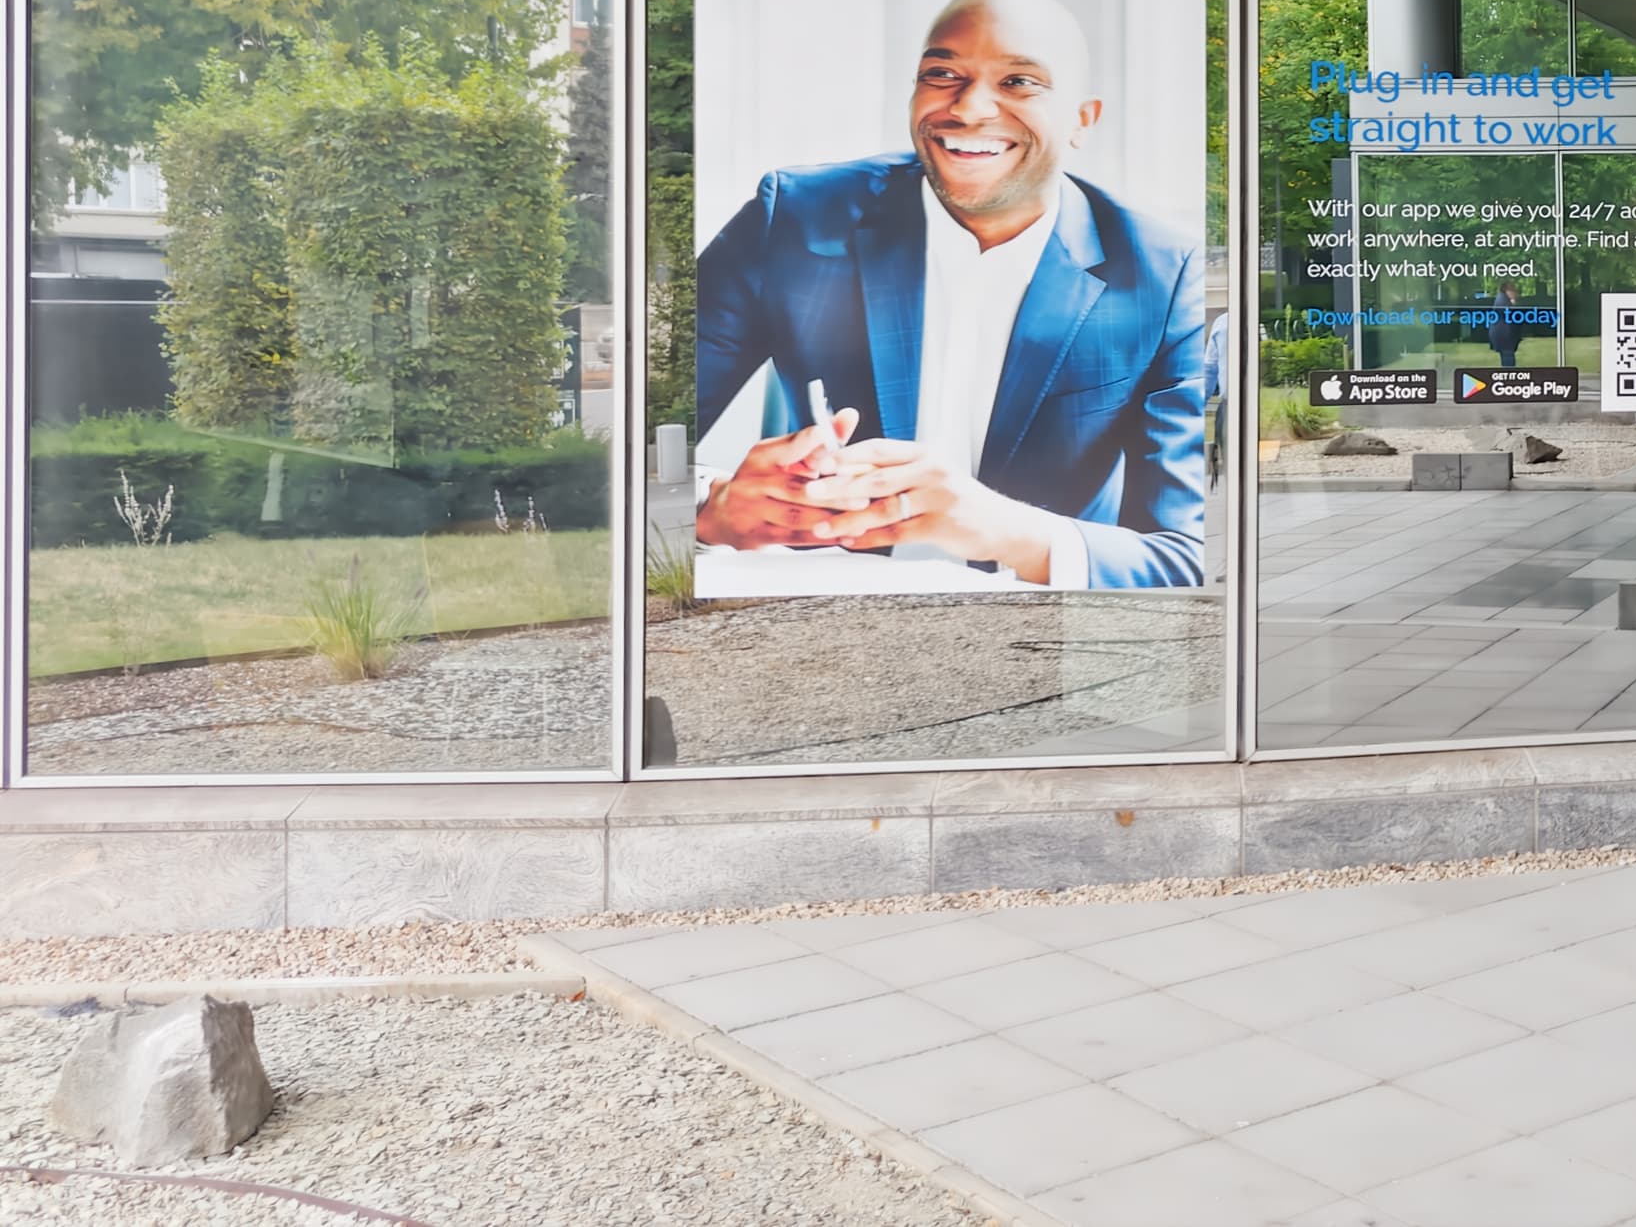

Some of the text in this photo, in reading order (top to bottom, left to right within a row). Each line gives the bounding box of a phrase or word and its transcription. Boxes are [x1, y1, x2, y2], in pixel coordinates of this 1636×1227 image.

[1310, 60, 1616, 107] Plug-in and get
[1309, 110, 1618, 153] straight to work
[1307, 199, 1355, 218] With
[1361, 202, 1397, 218] our
[1400, 202, 1441, 222] app
[1445, 203, 1476, 218] we
[1480, 200, 1523, 223] give
[1526, 203, 1562, 223] you
[1568, 202, 1616, 222] 24/7
[1307, 229, 1358, 248] work
[1363, 229, 1469, 252] anywhere,
[1474, 231, 1495, 248] at
[1498, 230, 1582, 252] anytime.
[1586, 230, 1629, 248] Find
[1306, 259, 1538, 282] exactly what you need.
[1307, 306, 1561, 329] Download our app today
[1350, 374, 1427, 384] Download on the
[1492, 373, 1508, 381] GET
[1508, 373, 1515, 381] IT
[1349, 384, 1427, 402] App Store
[1491, 381, 1572, 400] Google Play
